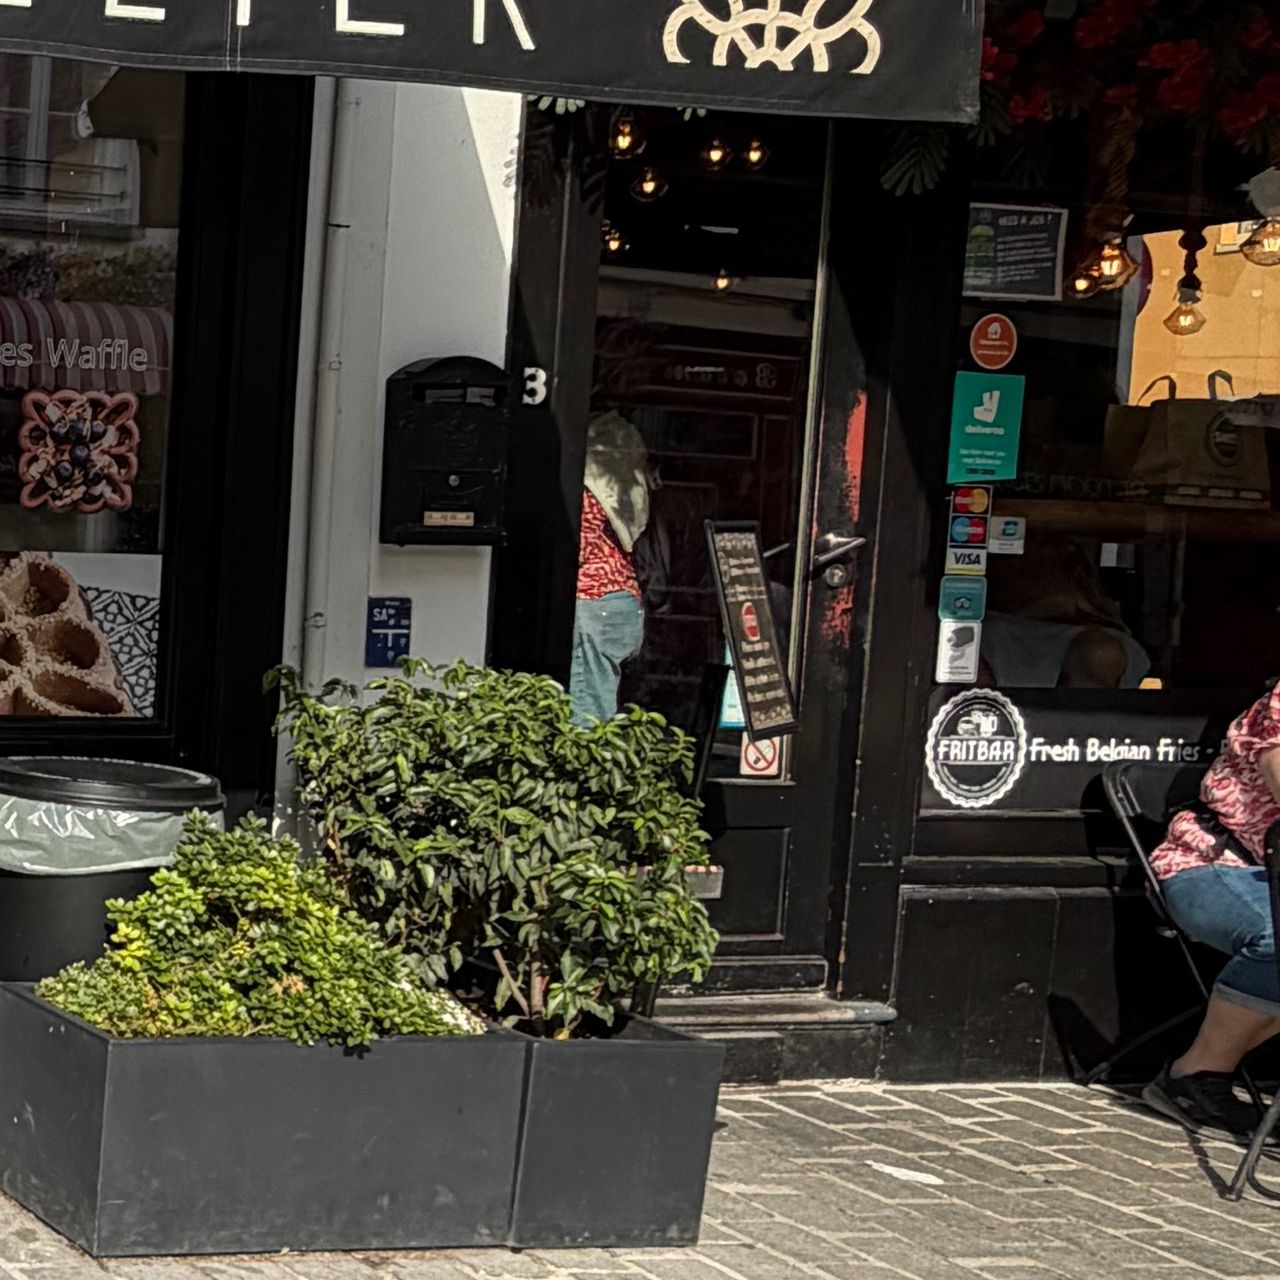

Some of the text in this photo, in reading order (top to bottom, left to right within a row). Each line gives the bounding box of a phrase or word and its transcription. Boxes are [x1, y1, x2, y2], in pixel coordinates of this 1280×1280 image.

[47, 338, 149, 371] Waffle
[521, 366, 547, 406] 3
[953, 552, 981, 565] VISA
[938, 740, 1014, 761] FRITBAR
[1028, 737, 1080, 762] Fresh
[1157, 738, 1200, 762] Fries
